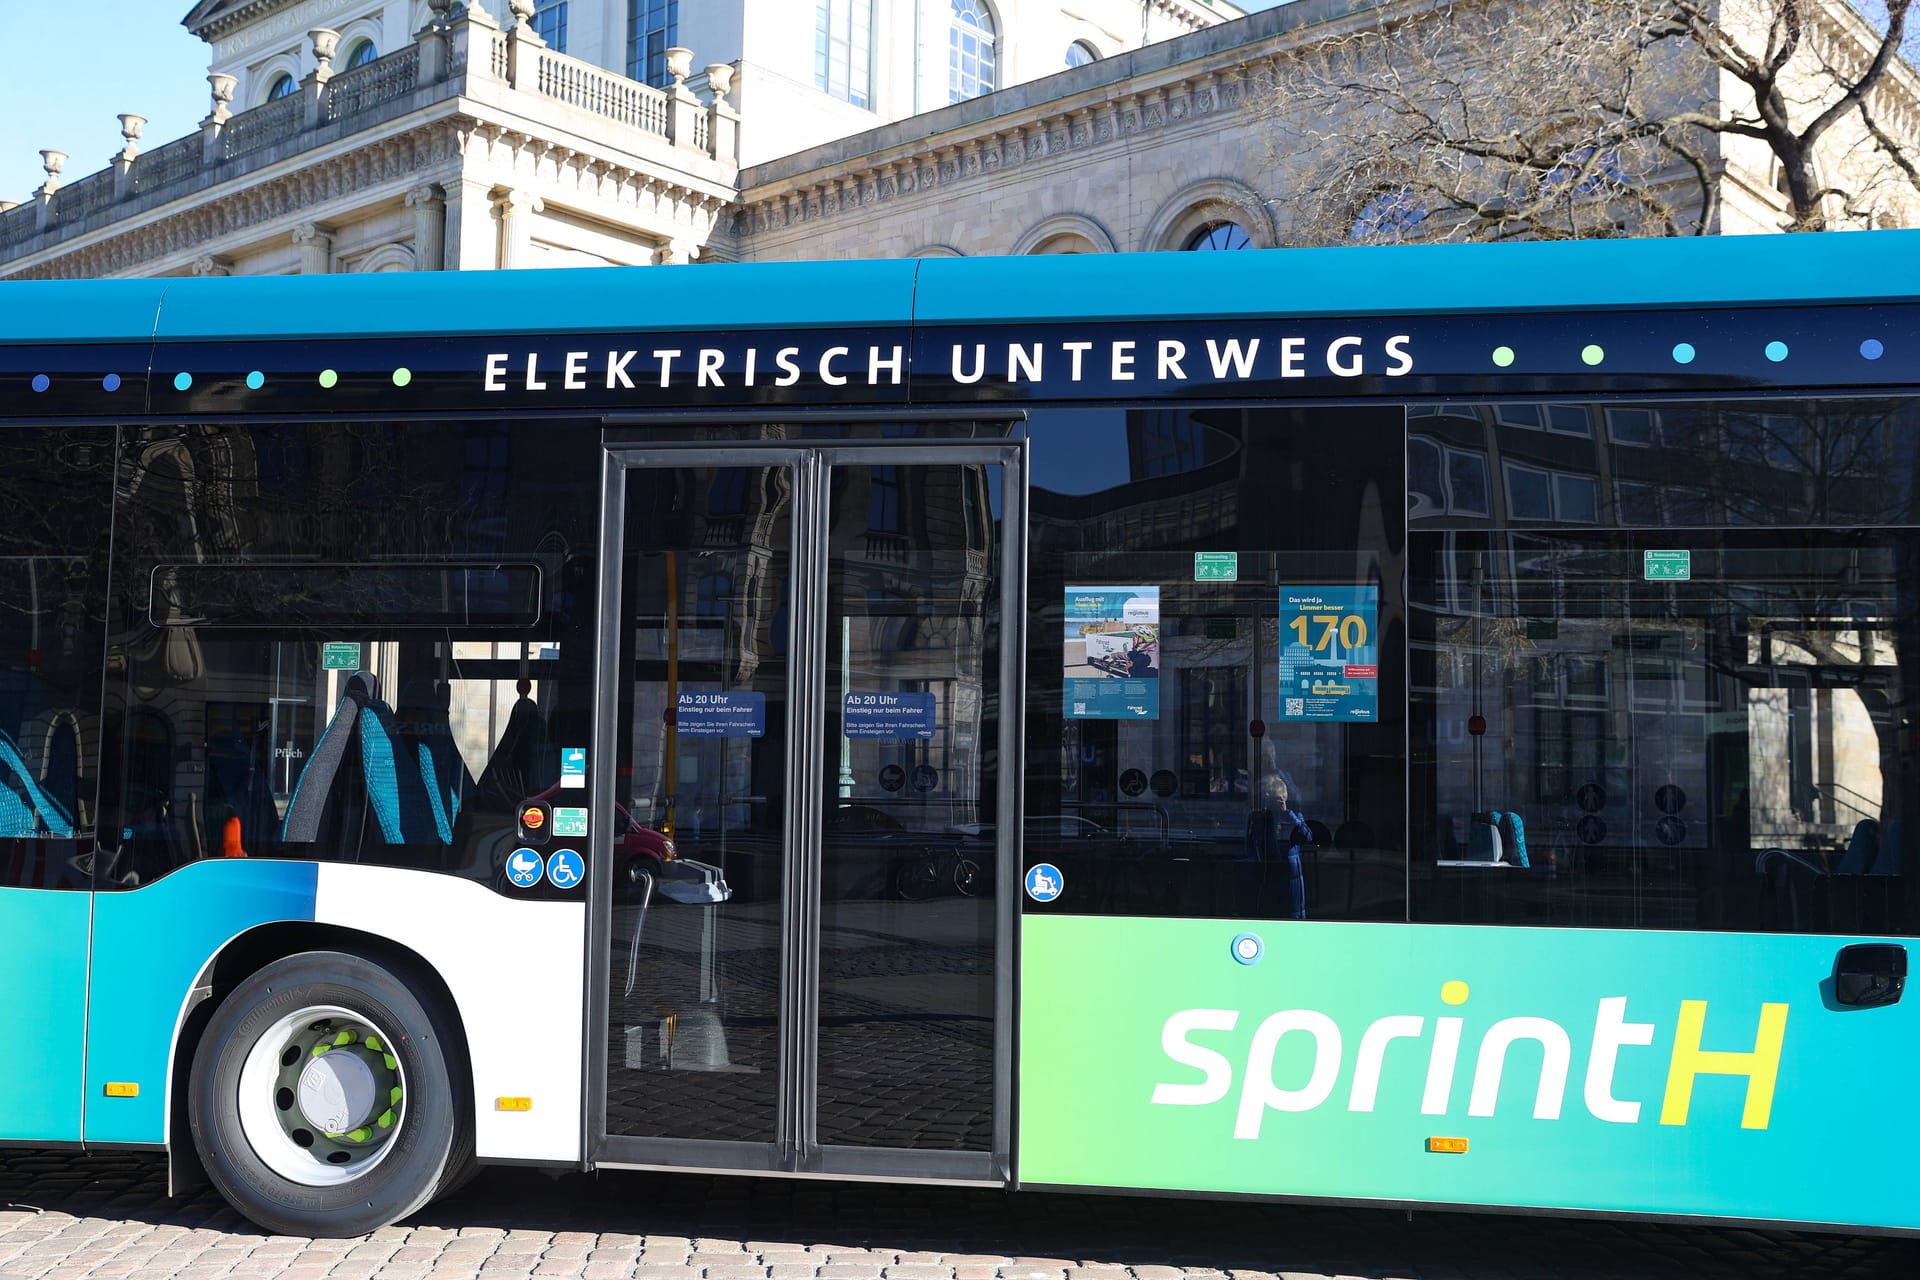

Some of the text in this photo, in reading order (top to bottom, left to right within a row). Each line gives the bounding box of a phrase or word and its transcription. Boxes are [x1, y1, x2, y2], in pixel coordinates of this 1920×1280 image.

[484, 335, 1413, 392] ELEKTRISCH UNTERWEGS
[1289, 615, 1367, 651] 170
[678, 706, 703, 714] Einstieg
[679, 694, 728, 704] Ab 20 Uhr
[847, 695, 898, 704] Ab 20 Uhr
[1150, 980, 1789, 1140] sprintH
